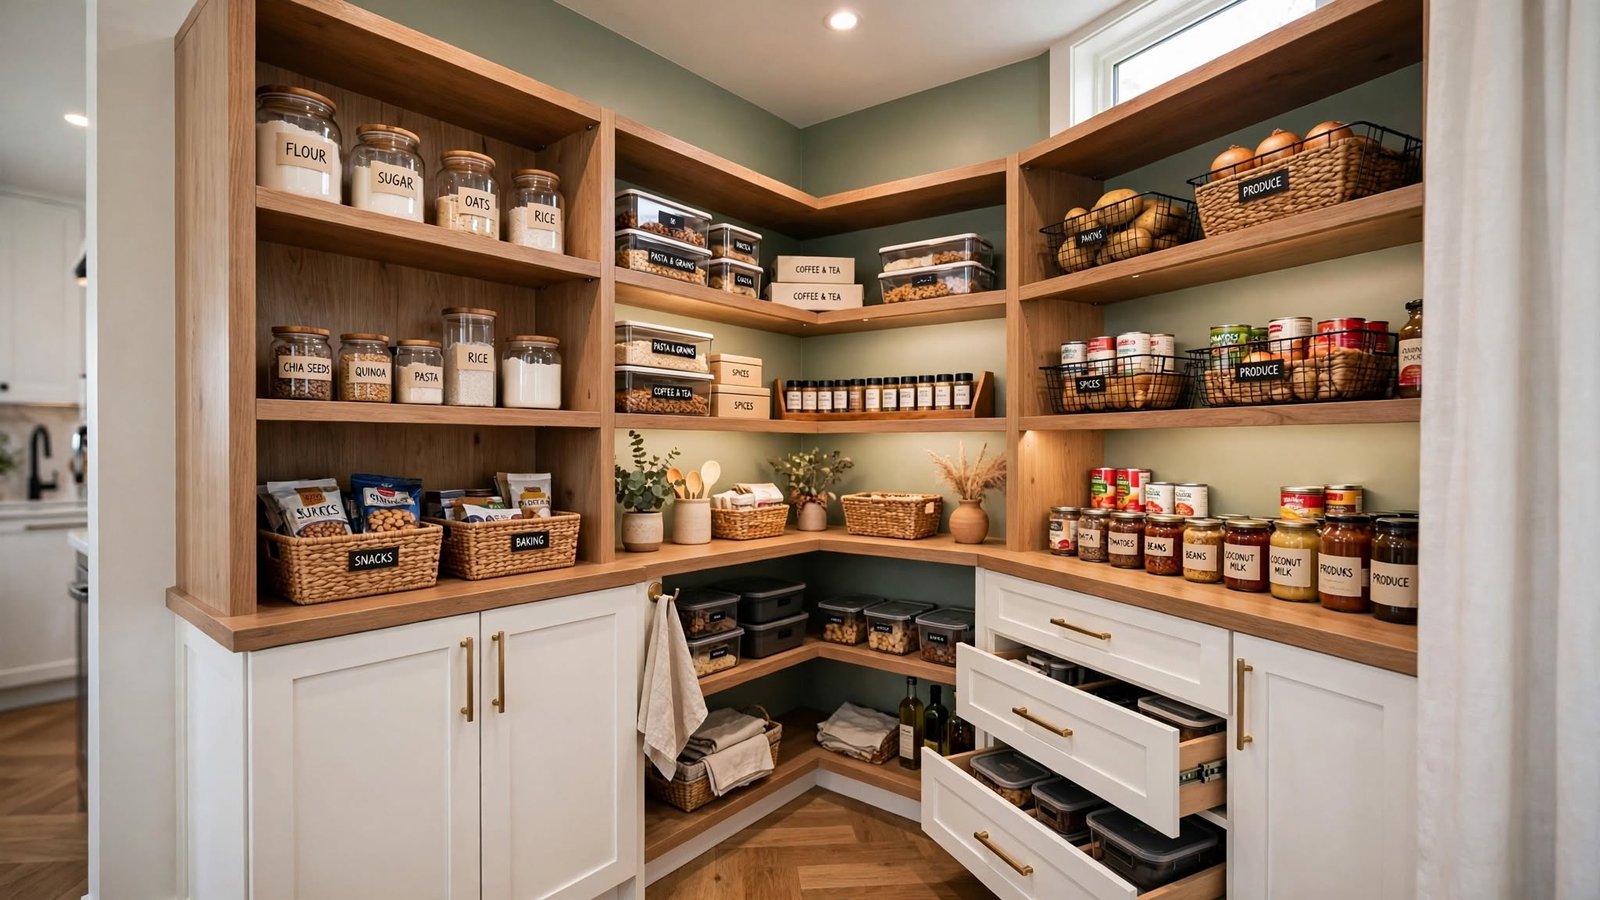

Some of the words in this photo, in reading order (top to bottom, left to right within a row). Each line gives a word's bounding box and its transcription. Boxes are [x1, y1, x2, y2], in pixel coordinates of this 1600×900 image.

[285, 142, 327, 164] FLOUR
[377, 171, 414, 191] SUGAR
[1243, 175, 1282, 198] PRODUCE
[465, 195, 490, 211] OATS
[534, 210, 555, 225] RICE
[651, 252, 668, 264] PASTA
[670, 257, 674, 265] &
[675, 258, 695, 271] GRAINS
[795, 265, 820, 274] COFFEE
[821, 265, 827, 274] &
[828, 265, 841, 275] TEA
[793, 291, 819, 301] COFFEE
[820, 292, 826, 301] &
[828, 291, 841, 301] TEA
[653, 341, 670, 351] PASTA
[676, 346, 695, 356] GRAINS
[467, 351, 488, 364] RICE
[283, 362, 305, 373] CHIA
[307, 363, 330, 375] SEEDS
[355, 366, 387, 378] QUINOA
[732, 369, 749, 378] SPICES
[1239, 364, 1279, 378] PRODUCE
[414, 371, 439, 383] PASTA
[653, 387, 675, 397] COFFEE
[681, 389, 692, 398] TEA
[734, 401, 754, 411] SPICES
[516, 534, 544, 547] BAKING
[1147, 541, 1167, 552] BEANS
[354, 552, 393, 567] SNACKS
[1185, 550, 1207, 561] BEANS
[1224, 550, 1255, 562] COCONUT
[1270, 554, 1302, 567] COCONUT
[1229, 562, 1247, 572] MILK
[1274, 566, 1293, 577] MILK
[1372, 572, 1409, 588] PRODUCE
